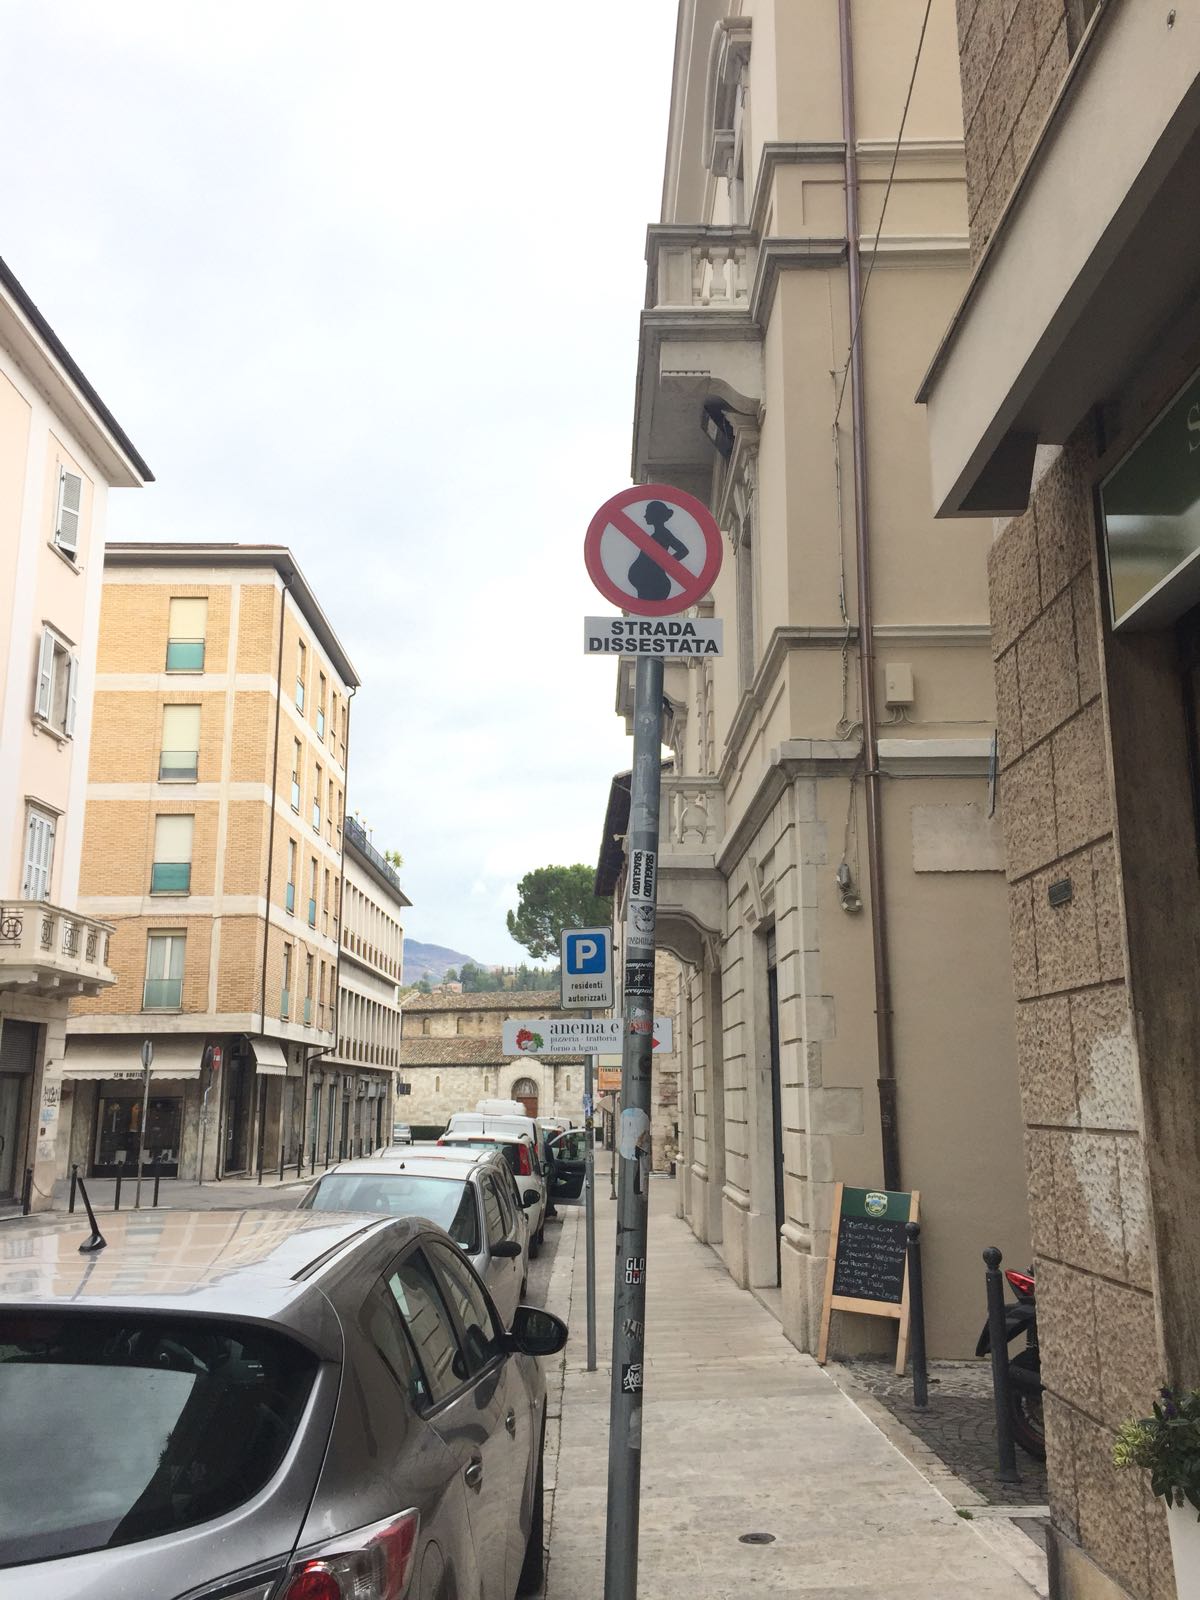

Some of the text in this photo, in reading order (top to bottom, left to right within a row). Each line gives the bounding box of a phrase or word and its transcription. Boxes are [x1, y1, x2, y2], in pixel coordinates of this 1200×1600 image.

[611, 621, 696, 636] STRADA
[589, 638, 719, 653] DISSESTATA
[575, 940, 598, 969] P
[571, 981, 603, 989] residenti
[568, 994, 607, 1003] autorizzati
[550, 1023, 619, 1035] anema e
[550, 1035, 579, 1044] pizzeria
[578, 1044, 598, 1052] legna
